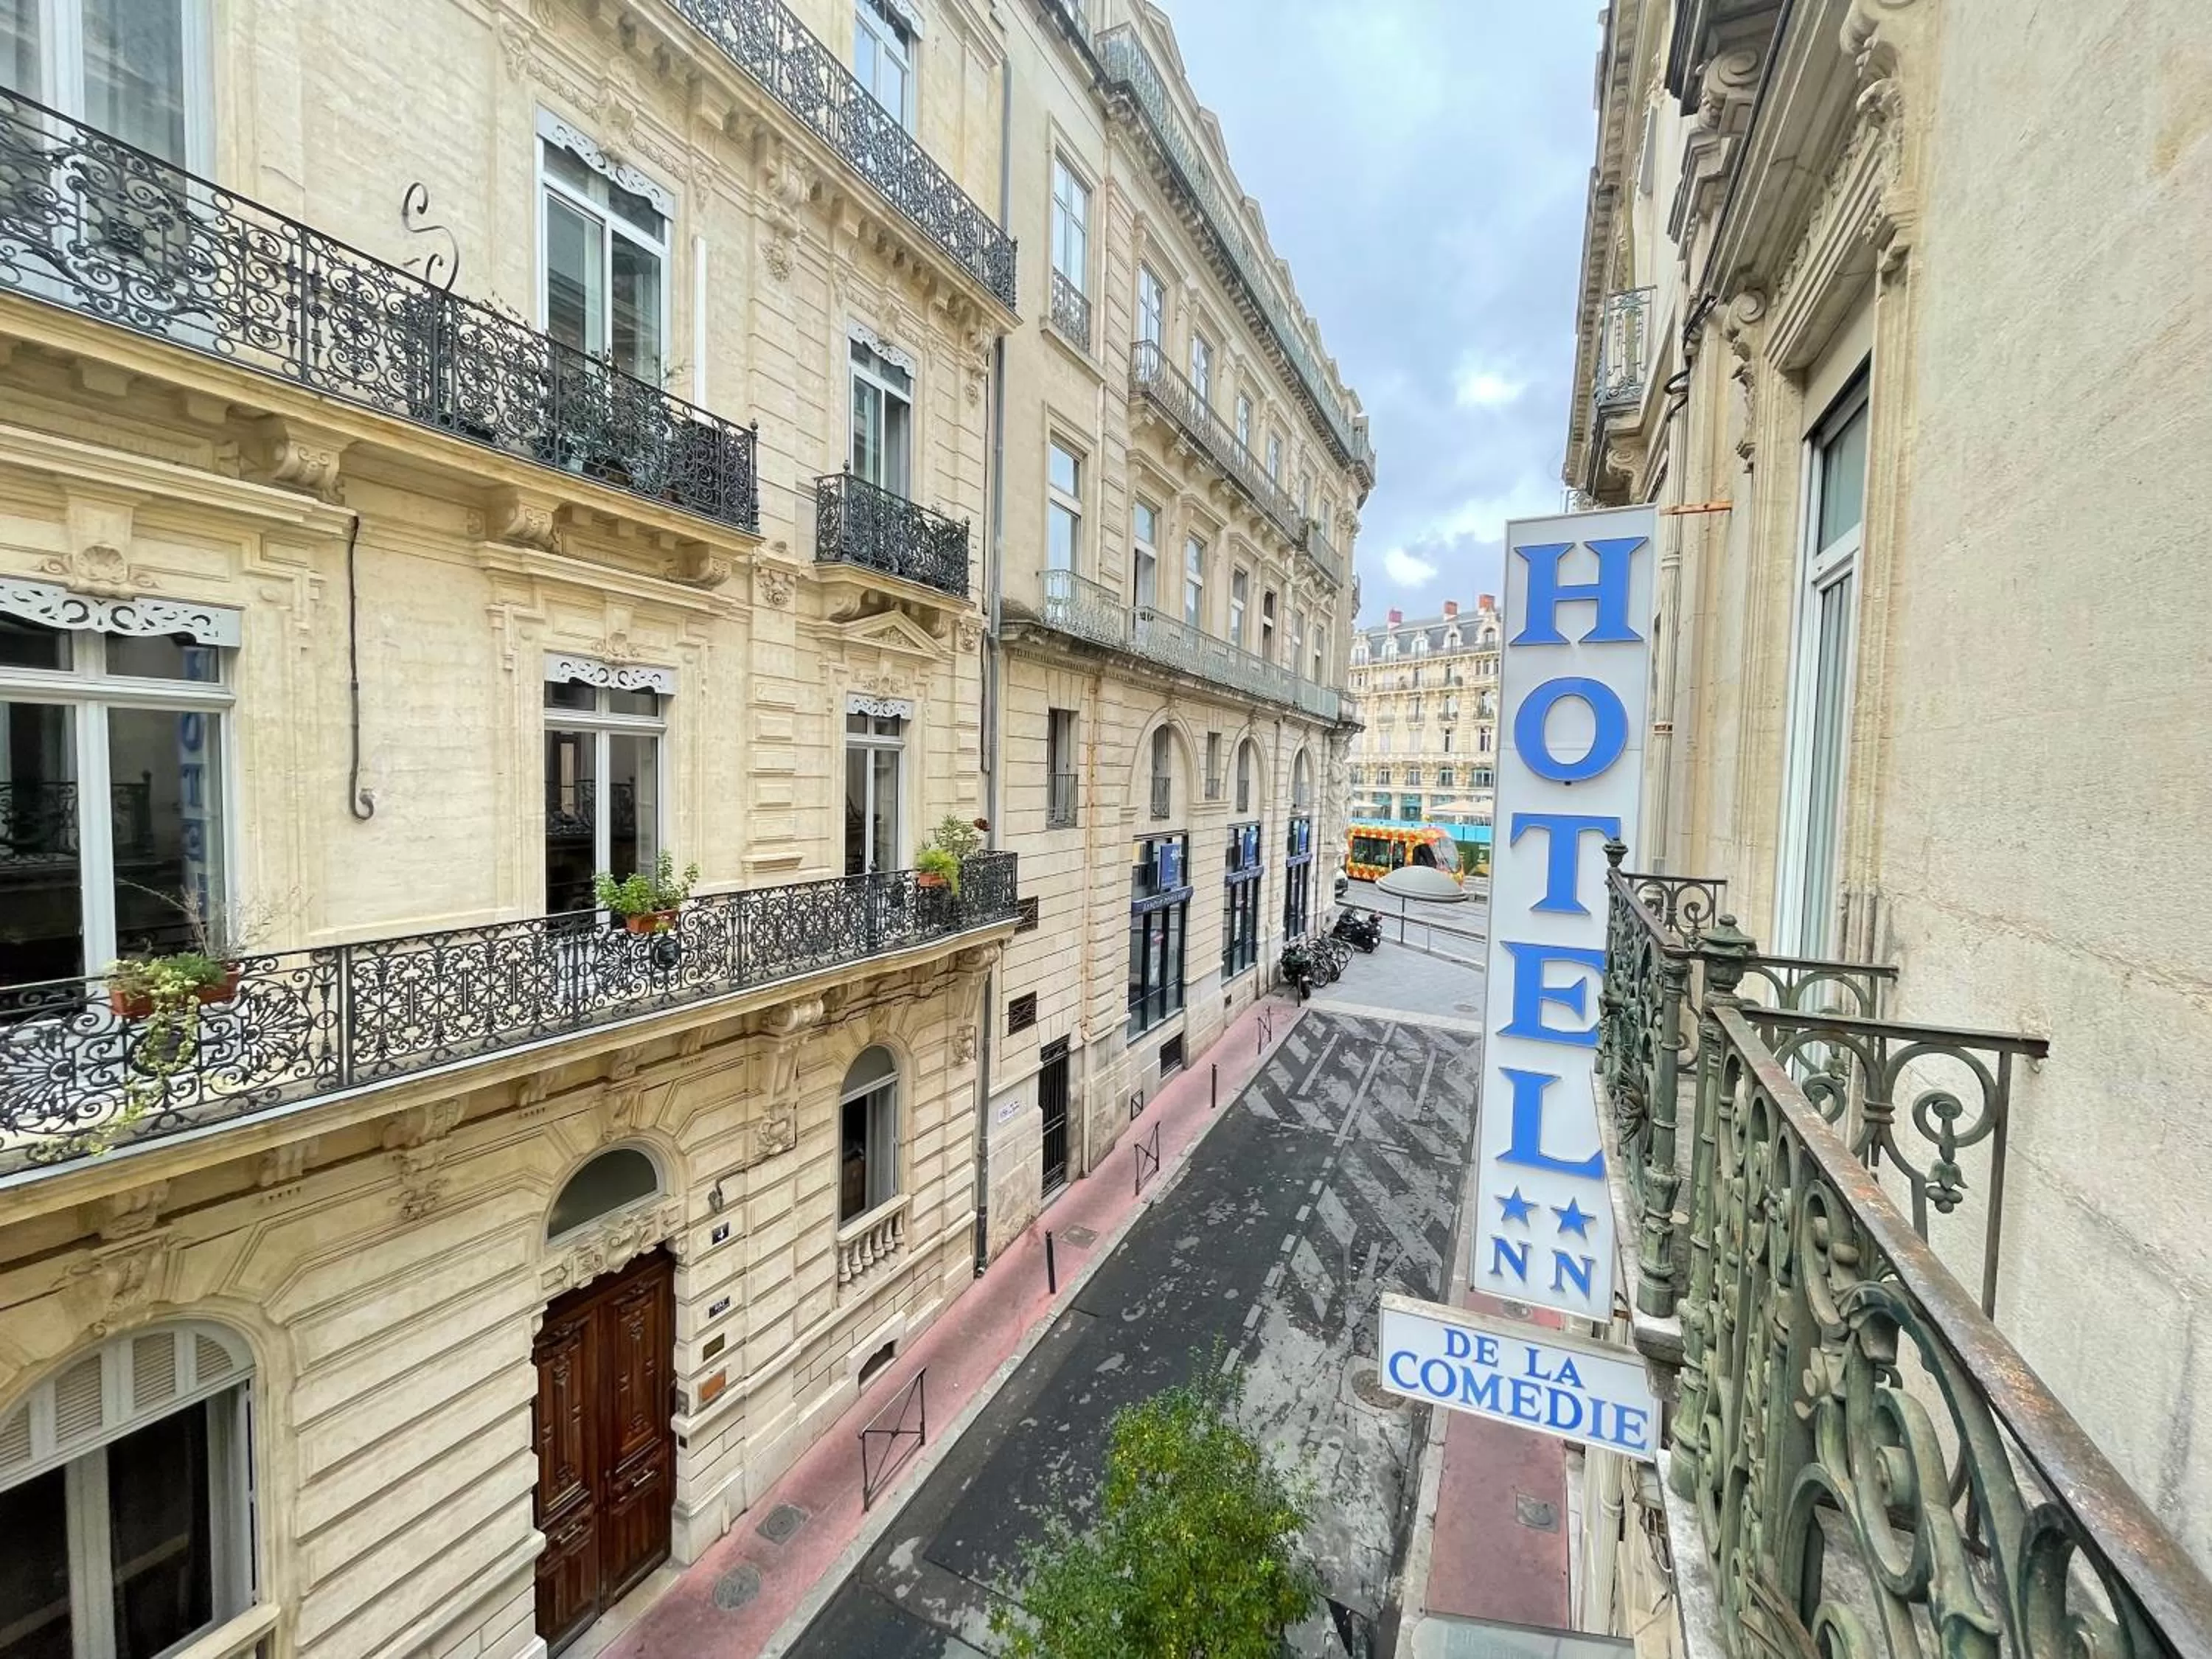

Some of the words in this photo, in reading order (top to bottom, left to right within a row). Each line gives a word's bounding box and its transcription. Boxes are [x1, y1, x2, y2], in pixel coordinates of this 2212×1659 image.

[1495, 536, 1649, 1180] HOTEL
[1388, 1350, 1649, 1450] COMEDIE
[1444, 1328, 1499, 1367] DE
[1524, 1346, 1585, 1389] LA
